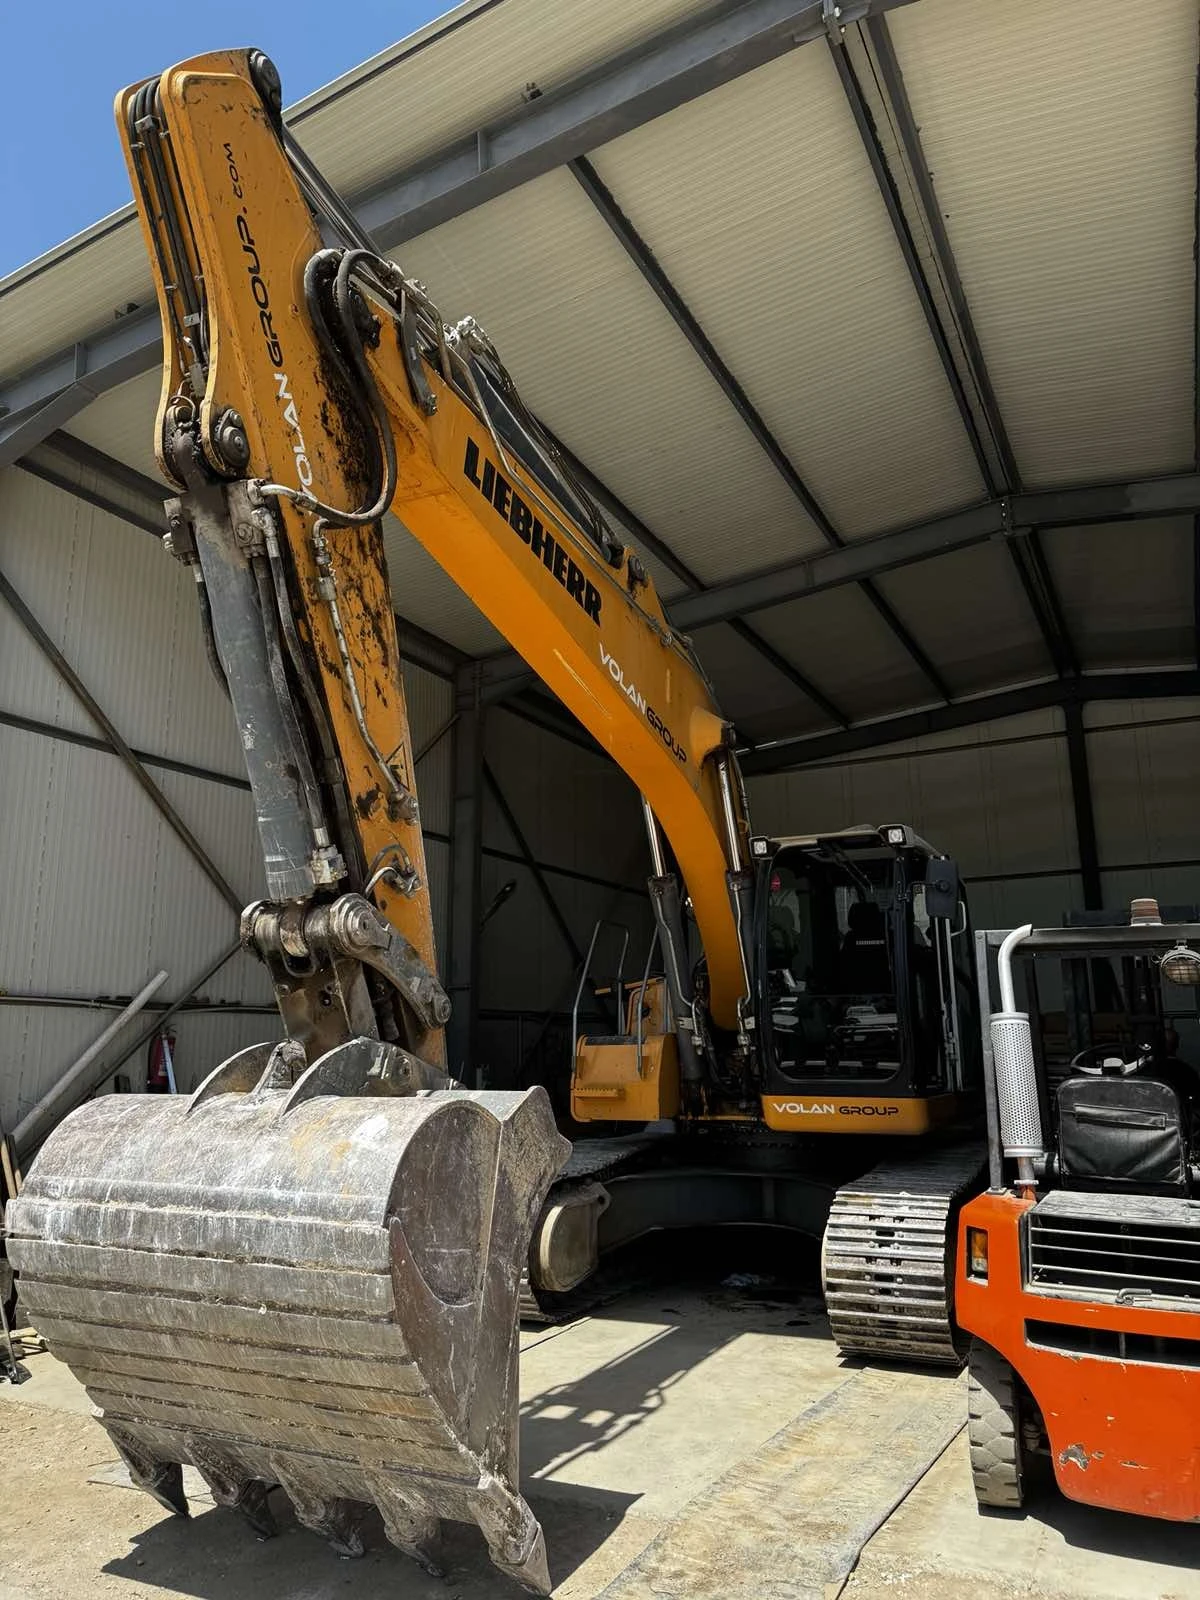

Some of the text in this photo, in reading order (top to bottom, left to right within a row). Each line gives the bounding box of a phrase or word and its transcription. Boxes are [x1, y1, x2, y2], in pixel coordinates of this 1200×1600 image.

[463, 436, 602, 628] LIEBHERR
[773, 1103, 899, 1115] VOLAN GROUP
